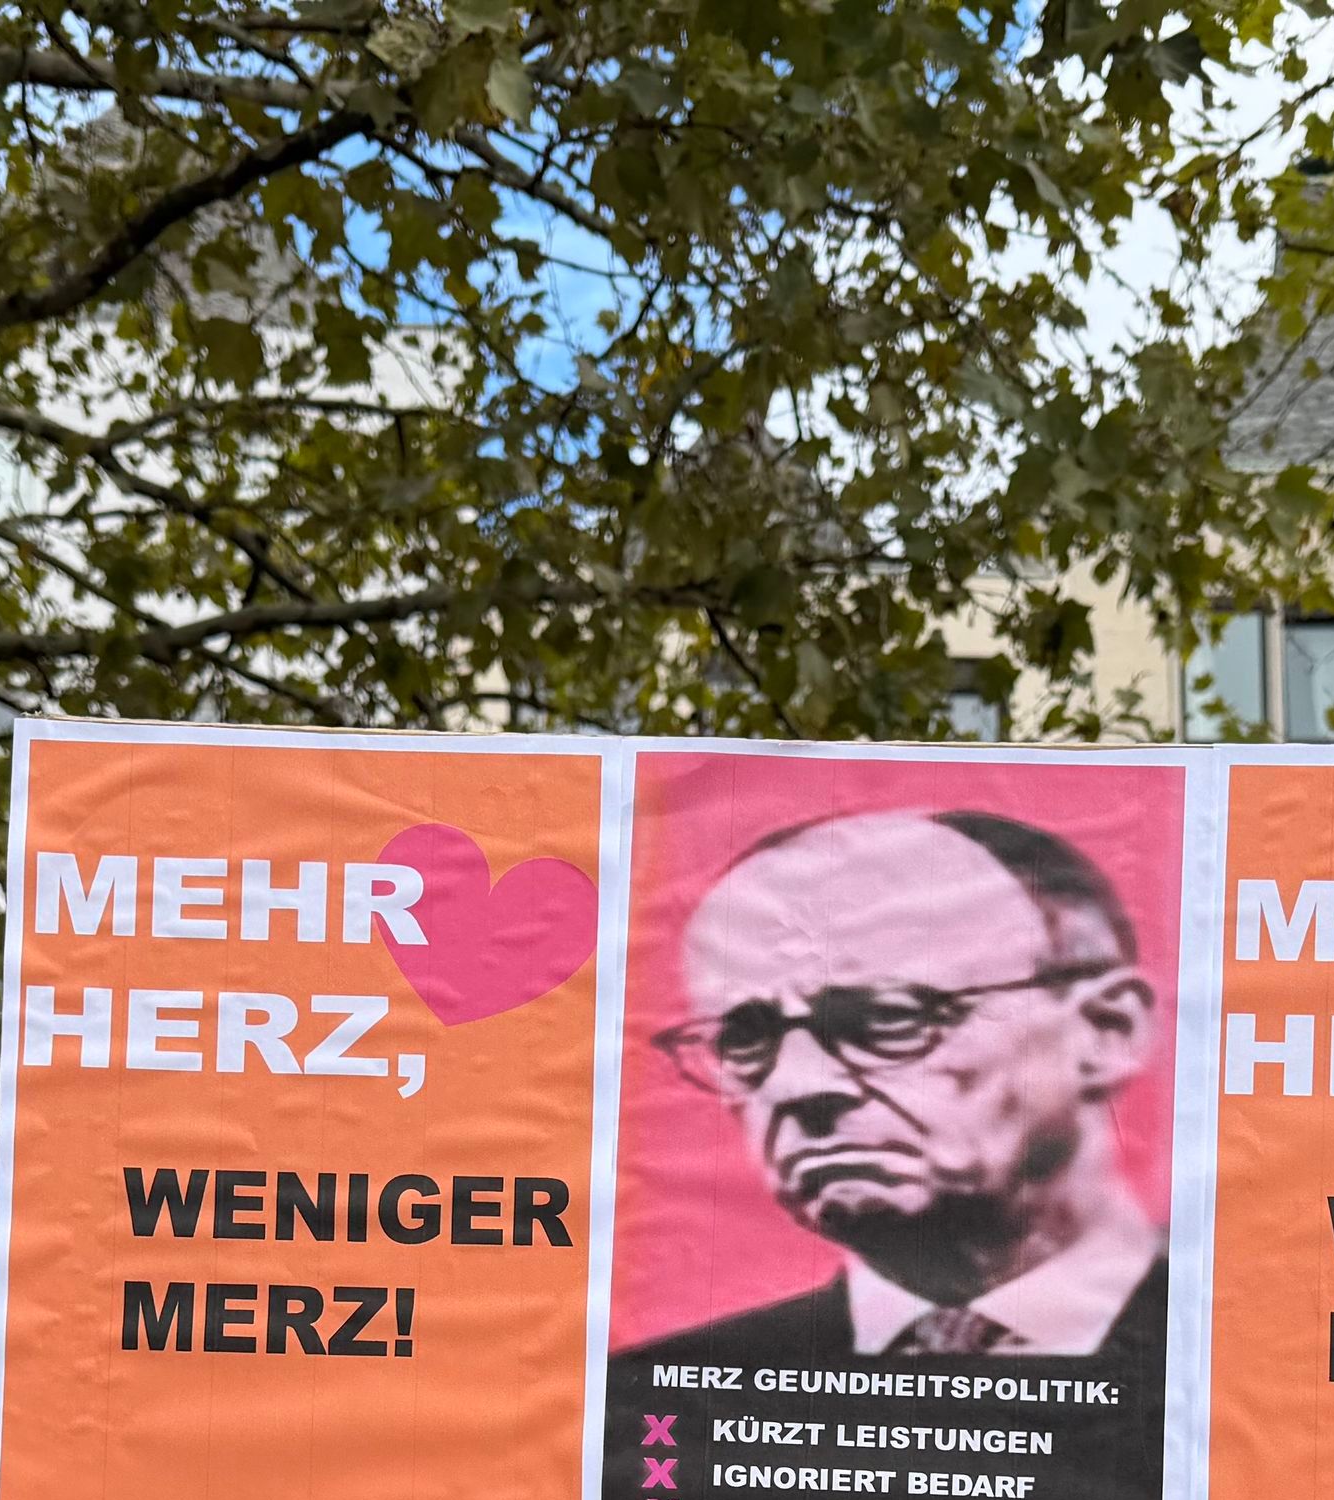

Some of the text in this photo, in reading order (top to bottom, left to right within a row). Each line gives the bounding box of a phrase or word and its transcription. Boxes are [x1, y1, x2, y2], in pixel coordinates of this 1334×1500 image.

[34, 850, 429, 946] MEHR
[22, 984, 426, 1099] HERZ,
[123, 1167, 574, 1247] WENIGER
[121, 1280, 415, 1358] MERZ!
[652, 1364, 1119, 1405] MERZ GEUNDHEITSPOLITIK:
[713, 1415, 826, 1446] KÜRZT
[836, 1424, 1053, 1455] LEISTUNGEN
[713, 1464, 897, 1493] IGNORIERT
[907, 1471, 1035, 1499] BEDARF
